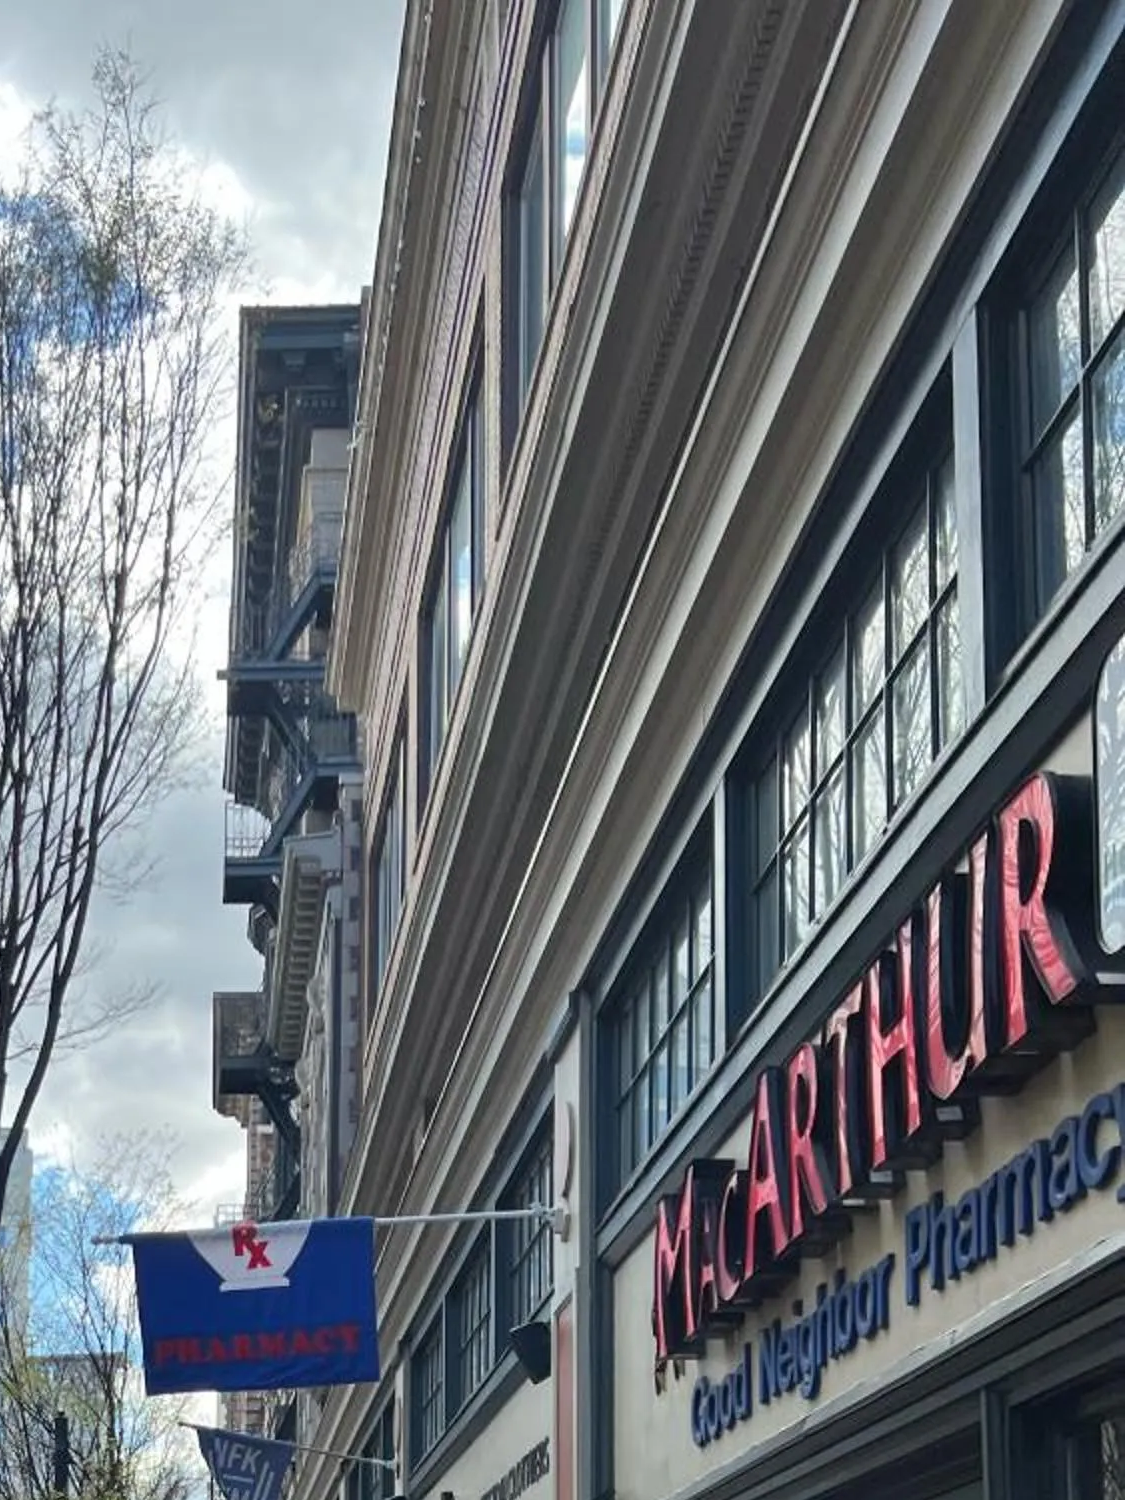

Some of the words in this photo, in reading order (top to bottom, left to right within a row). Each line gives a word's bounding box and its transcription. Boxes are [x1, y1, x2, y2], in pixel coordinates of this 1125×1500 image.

[155, 1322, 361, 1367] PHARMACY
[691, 1341, 753, 1448] Good
[759, 1253, 896, 1404] Neighbor
[905, 1082, 1125, 1307] Pharmac
